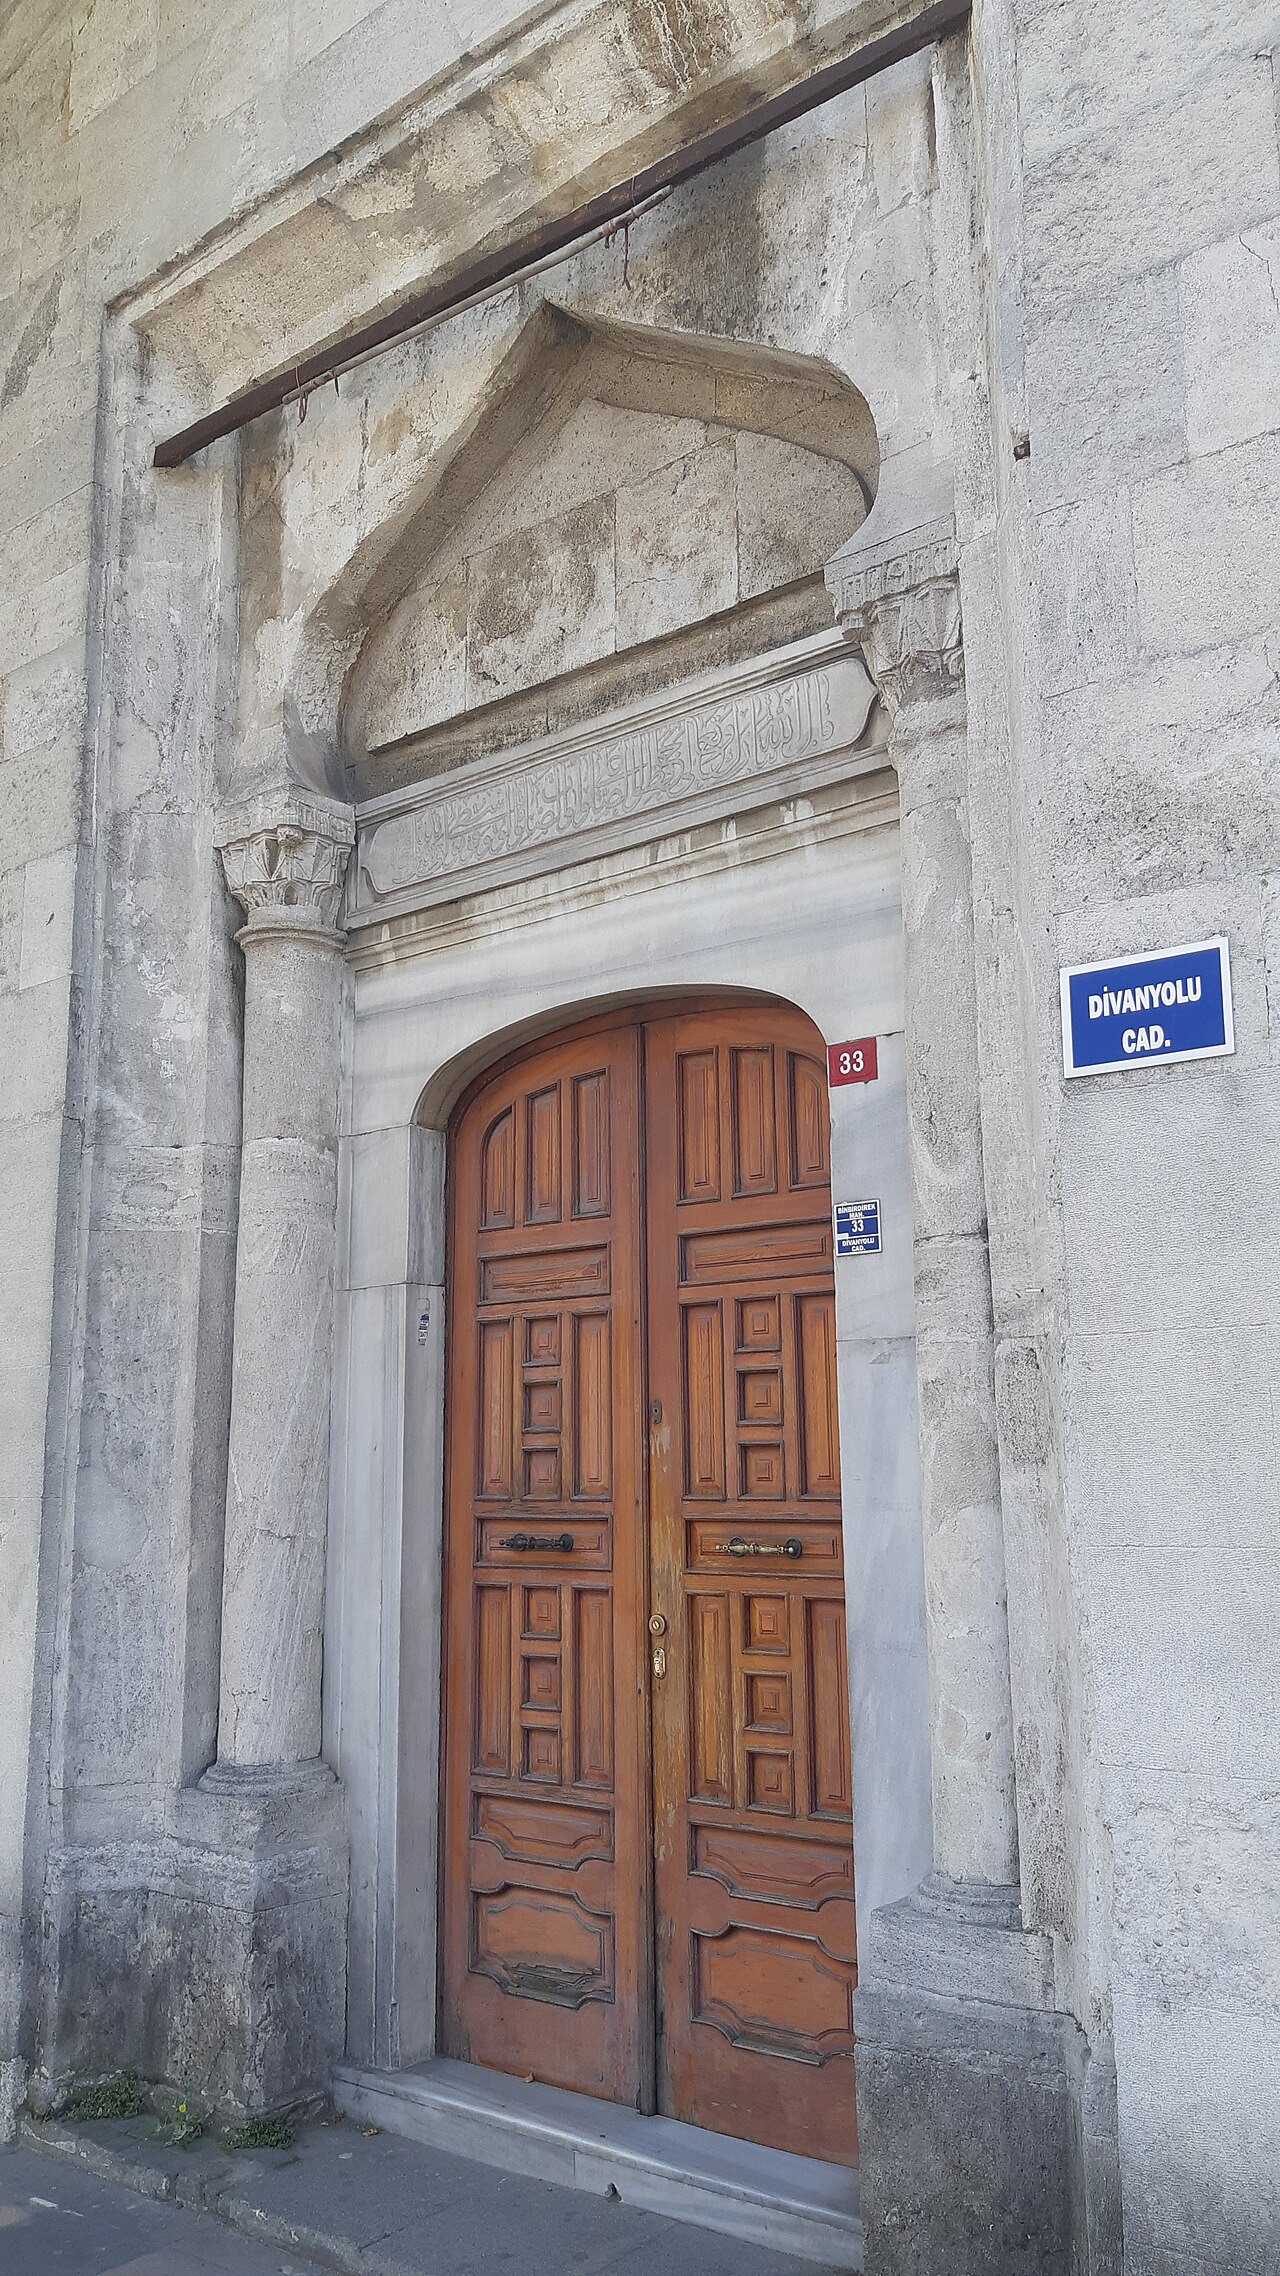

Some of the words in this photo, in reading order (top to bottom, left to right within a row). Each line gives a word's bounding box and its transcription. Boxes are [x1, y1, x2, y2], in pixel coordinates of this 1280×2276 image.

[1088, 976, 1202, 1019] DİVANYOLU
[1122, 1025, 1171, 1053] CAD.
[840, 1050, 864, 1075] 33
[838, 1204, 876, 1214] BİNBİRDİREK
[851, 1219, 864, 1232] 33
